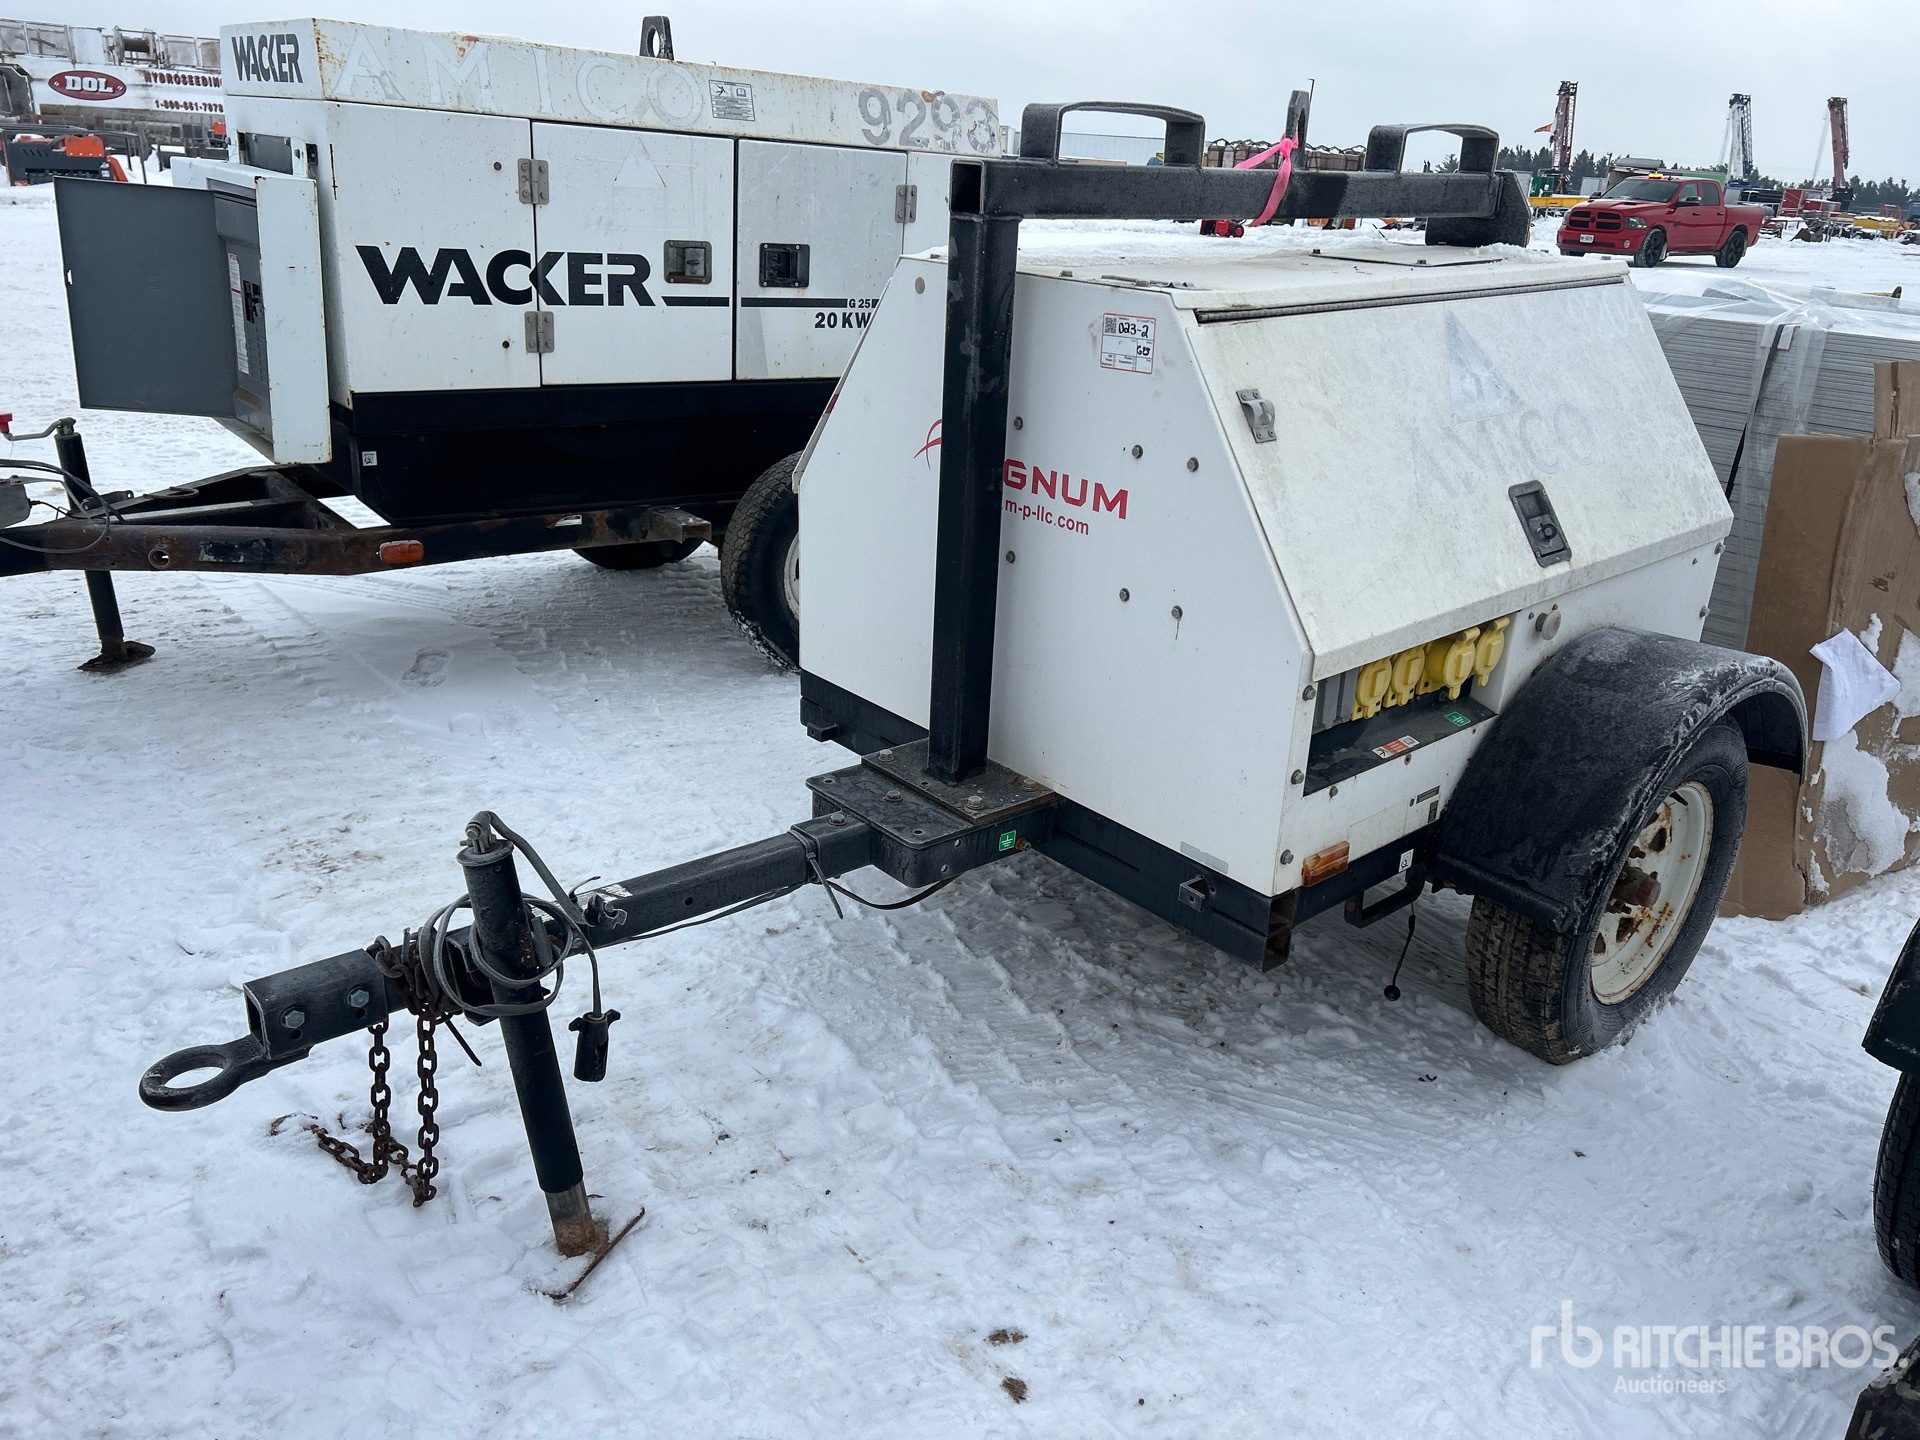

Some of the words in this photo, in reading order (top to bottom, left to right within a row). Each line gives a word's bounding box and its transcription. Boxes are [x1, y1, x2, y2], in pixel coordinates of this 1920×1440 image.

[231, 33, 303, 83] WACKER
[64, 75, 114, 93] DOL
[143, 69, 222, 88] HYDROSEEDIN
[355, 245, 656, 306] WACKER
[848, 298, 856, 309] G
[858, 298, 871, 309] 25
[814, 311, 838, 329] 20
[841, 311, 872, 329] KW
[1003, 458, 1129, 520] GNUM
